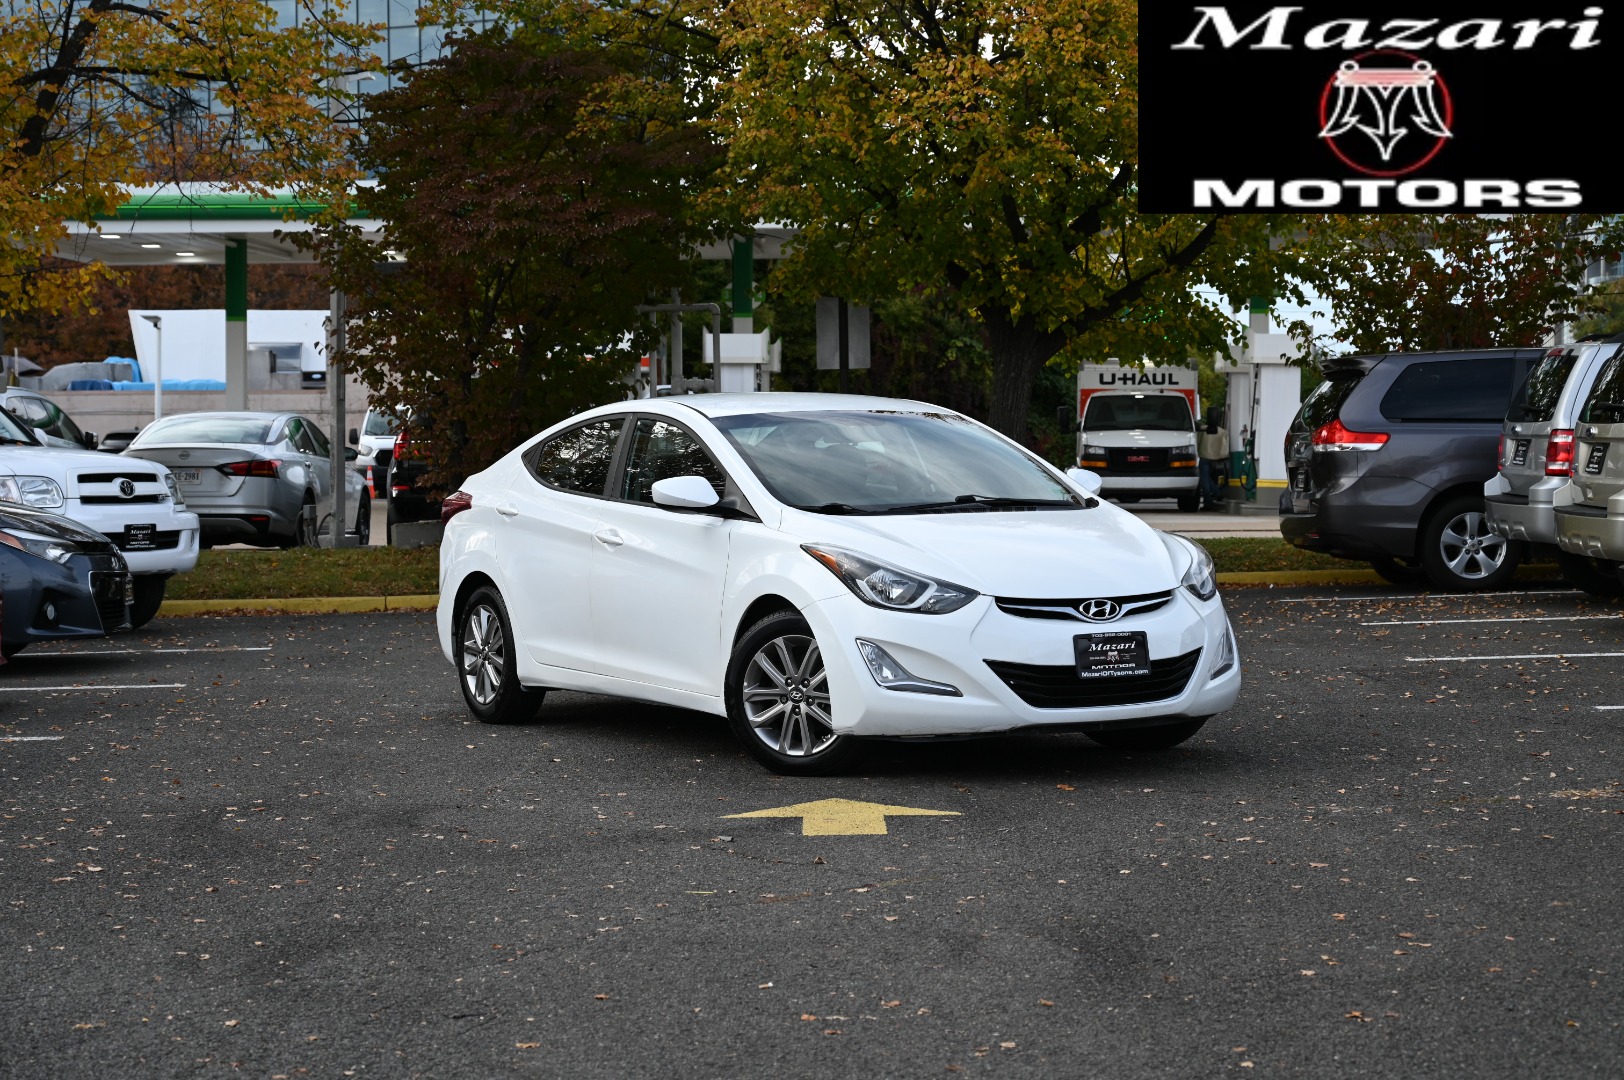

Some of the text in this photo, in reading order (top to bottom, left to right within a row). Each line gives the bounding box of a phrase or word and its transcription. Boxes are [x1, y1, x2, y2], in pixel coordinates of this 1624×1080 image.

[1099, 372, 1180, 386] U-HAUL
[1126, 455, 1150, 463] GMC
[1088, 640, 1136, 652] Mazari
[1081, 669, 1149, 678] MazariOfTysons.com
